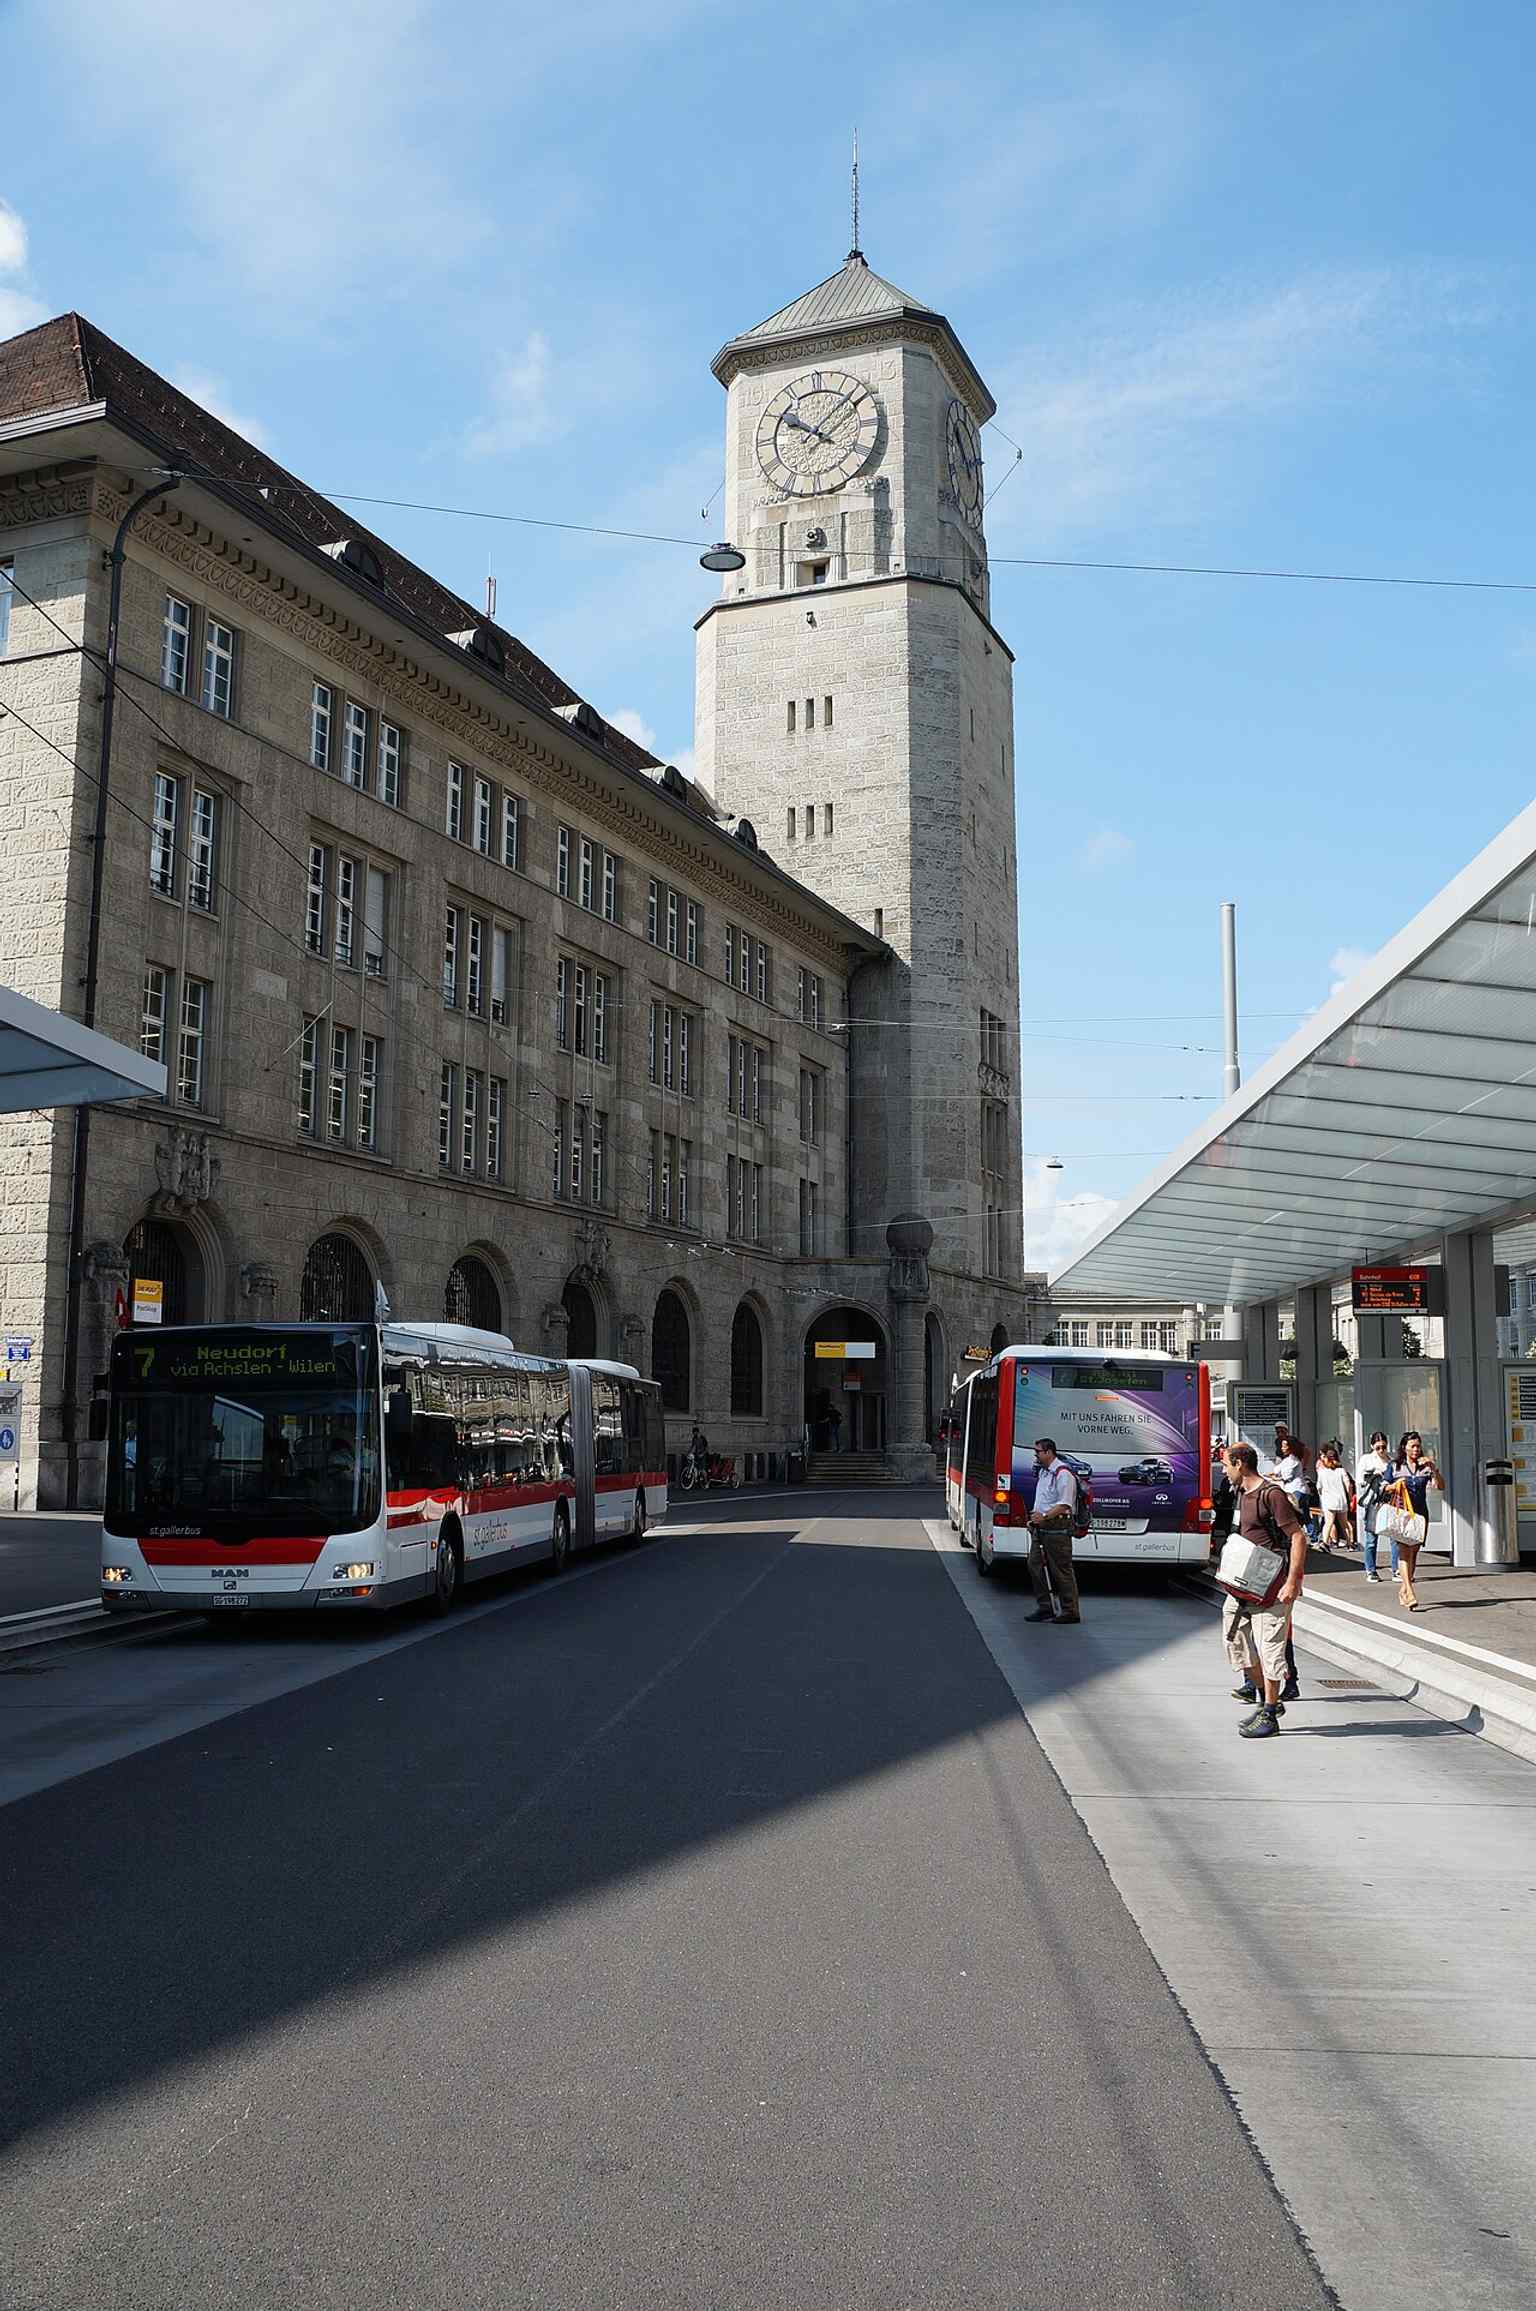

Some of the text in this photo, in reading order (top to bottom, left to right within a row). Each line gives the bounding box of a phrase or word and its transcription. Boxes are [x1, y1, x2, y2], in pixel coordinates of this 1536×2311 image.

[197, 1344, 287, 1360] Neudorf
[134, 1347, 154, 1377] 7
[170, 1362, 199, 1376] via
[204, 1361, 271, 1375] Achslen
[288, 1360, 336, 1374] Wilen
[1060, 1412, 1152, 1423] MIT UNS FAHREN SIE
[1077, 1424, 1134, 1435] VORNE WEG.
[149, 1524, 201, 1537] st.gallerbus
[1135, 1543, 1176, 1552] st.gallerbus
[211, 1568, 249, 1578] MAN
